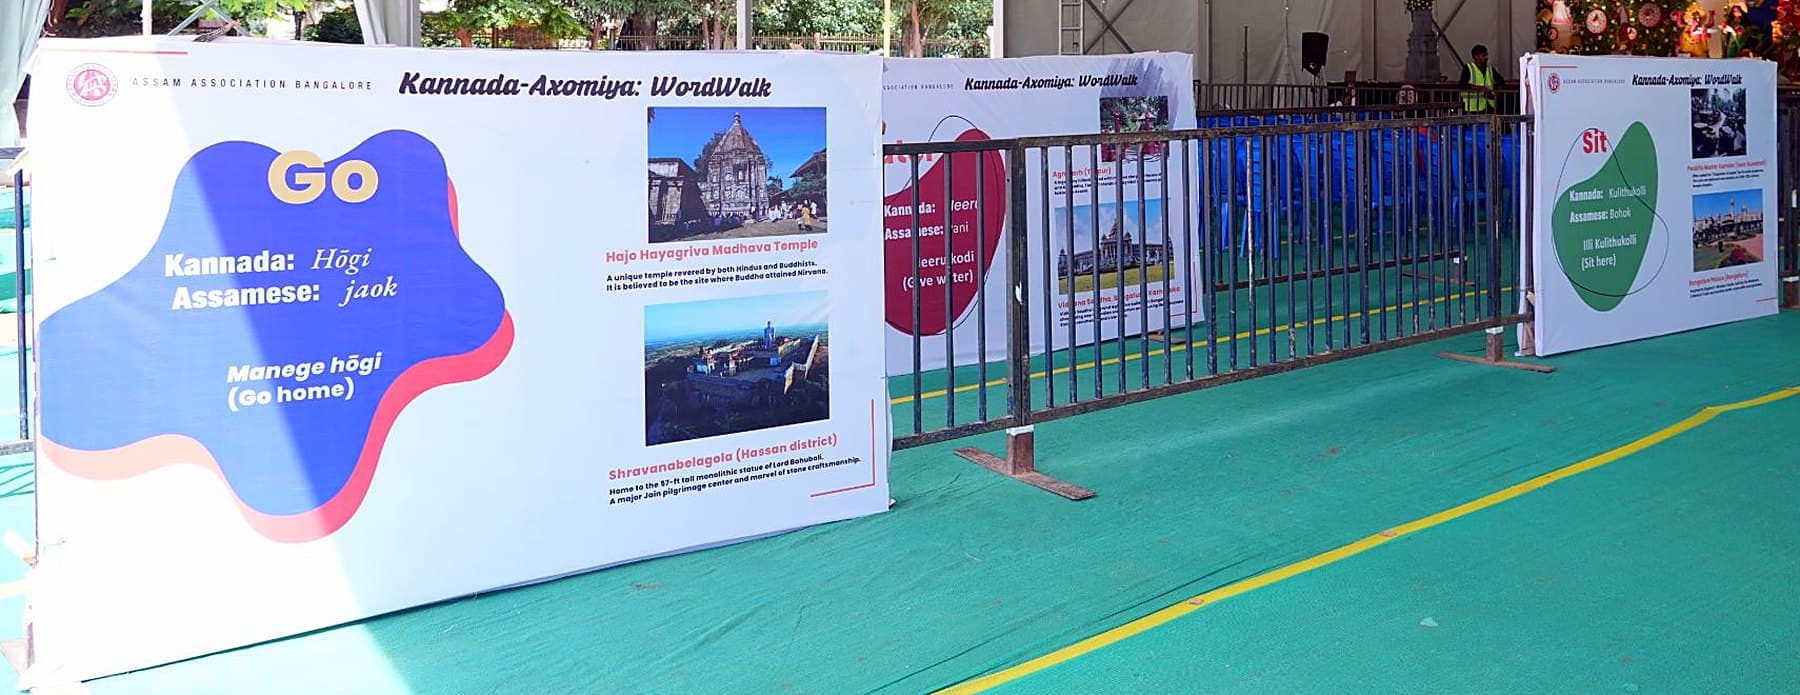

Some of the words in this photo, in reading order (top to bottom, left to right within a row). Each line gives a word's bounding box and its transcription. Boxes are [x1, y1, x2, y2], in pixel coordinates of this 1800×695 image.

[132, 77, 181, 87] ASSAM
[191, 78, 286, 88] ASSOCIATION
[295, 79, 372, 90] BANGALORE
[399, 72, 641, 100] Kannada-Axomiya:
[650, 76, 772, 98] WordWalk
[964, 75, 1075, 90] Kannada-Axomiya:
[1078, 74, 1138, 87] WordWalk
[1704, 74, 1743, 85] WordWalk
[1582, 128, 1607, 153] Sit
[267, 149, 379, 205] Go
[1569, 188, 1604, 202] Kannada:
[884, 201, 936, 217] Kannda:
[1570, 210, 1609, 223] Assamese:
[885, 225, 944, 240] Assaese:
[951, 221, 969, 233] ani
[164, 250, 295, 277] Kannada:
[311, 248, 373, 275] Hōgi
[606, 249, 637, 265] Hajo
[640, 245, 709, 262] Hayagriva
[712, 243, 771, 255] Madhava
[774, 239, 818, 252] Temple
[919, 256, 946, 268] eeru
[952, 250, 975, 264] kodi
[1581, 257, 1595, 271] (Sit
[1596, 253, 1616, 267] here)
[614, 273, 643, 282] unique
[644, 270, 673, 279] temple
[674, 268, 705, 277] revered
[706, 267, 716, 276] by
[717, 265, 735, 274] both
[736, 264, 762, 272] Hindus
[763, 262, 778, 270] and
[779, 260, 818, 269] Buddhists.
[614, 283, 621, 291] is
[623, 281, 658, 290] believed
[710, 274, 734, 282] where
[735, 272, 764, 281] Buddha
[765, 270, 796, 279] attained
[798, 268, 829, 276] Nirvana.
[903, 276, 933, 292] (Gve
[936, 269, 973, 285] wter)
[172, 284, 320, 310] Assamese:
[338, 276, 398, 307] jaok
[226, 360, 325, 383] Manege
[330, 352, 383, 376] hōgi
[228, 386, 272, 412] (Go
[277, 377, 355, 403] home)
[608, 452, 733, 480] Shravanabelagola
[736, 444, 787, 462] (Hassan
[790, 433, 838, 451] district)
[609, 486, 634, 495] Home
[645, 481, 659, 490] the
[660, 478, 680, 487] 57-ft
[681, 475, 695, 483] tall
[696, 468, 738, 481] monolithic
[739, 464, 763, 474] statue
[764, 462, 773, 470] of
[773, 459, 789, 468] Lord
[790, 454, 824, 465] Bahubali.
[617, 494, 642, 504] major
[644, 490, 661, 499] Jain
[662, 483, 707, 498] pilgrimage
[708, 478, 733, 488] center
[734, 475, 749, 484] and
[750, 470, 777, 481] marvel
[778, 468, 786, 476] of
[786, 465, 807, 475] stone
[807, 456, 861, 471] craftsmanship.
